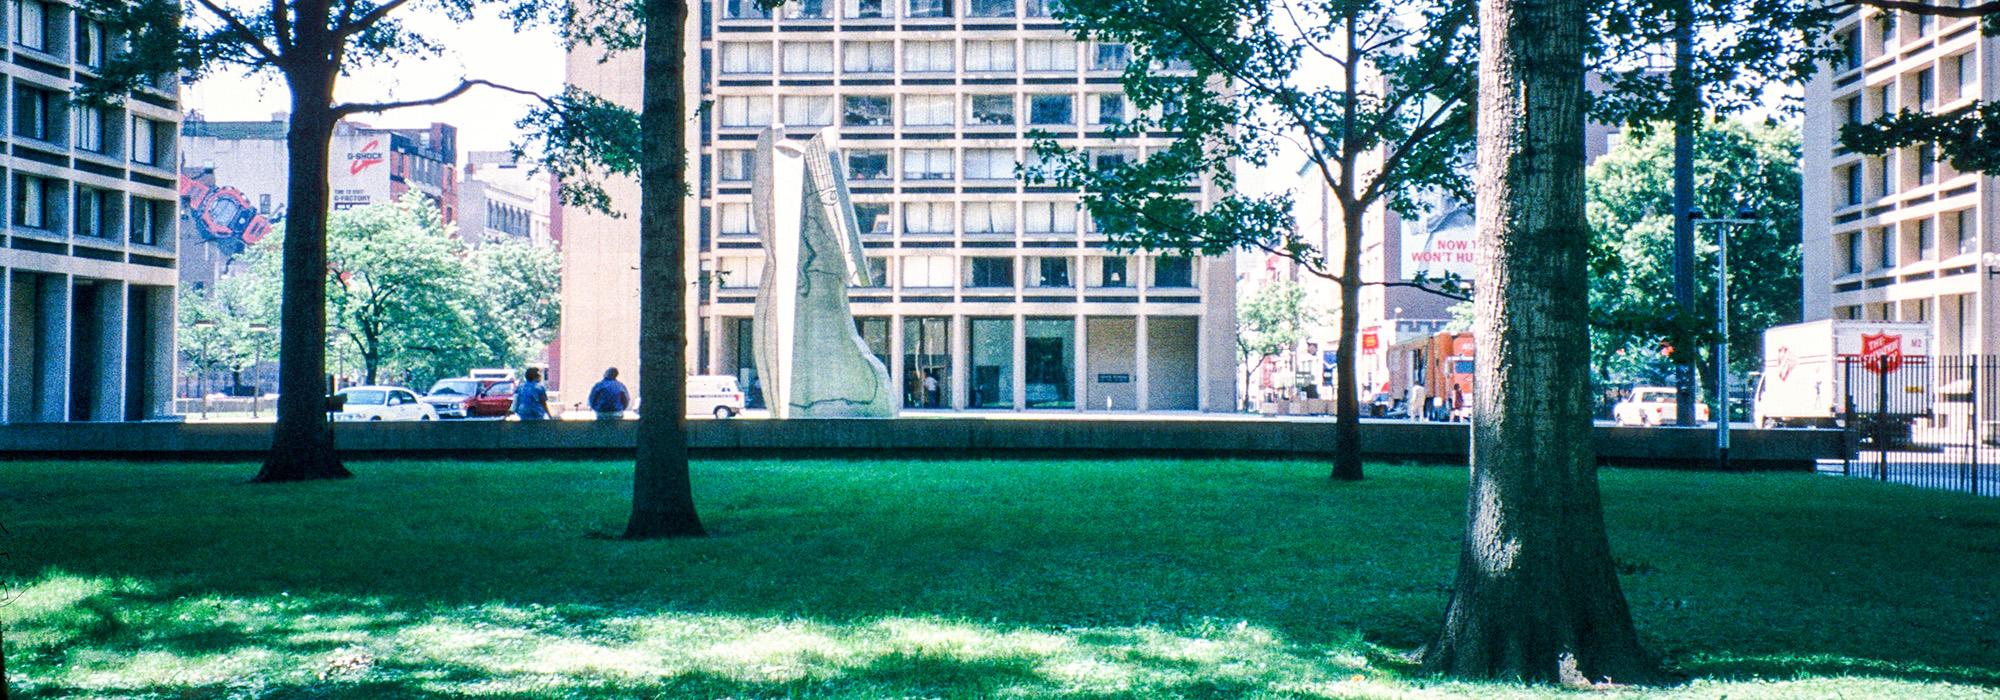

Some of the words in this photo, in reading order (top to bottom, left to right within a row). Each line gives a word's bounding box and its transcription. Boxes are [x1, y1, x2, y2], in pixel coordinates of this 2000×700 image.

[347, 152, 383, 160] G-SHOCK
[1437, 240, 1468, 250] NOW
[1411, 252, 1453, 262] WON'T
[1456, 252, 1475, 262] HU
[1868, 337, 1887, 351] THE
